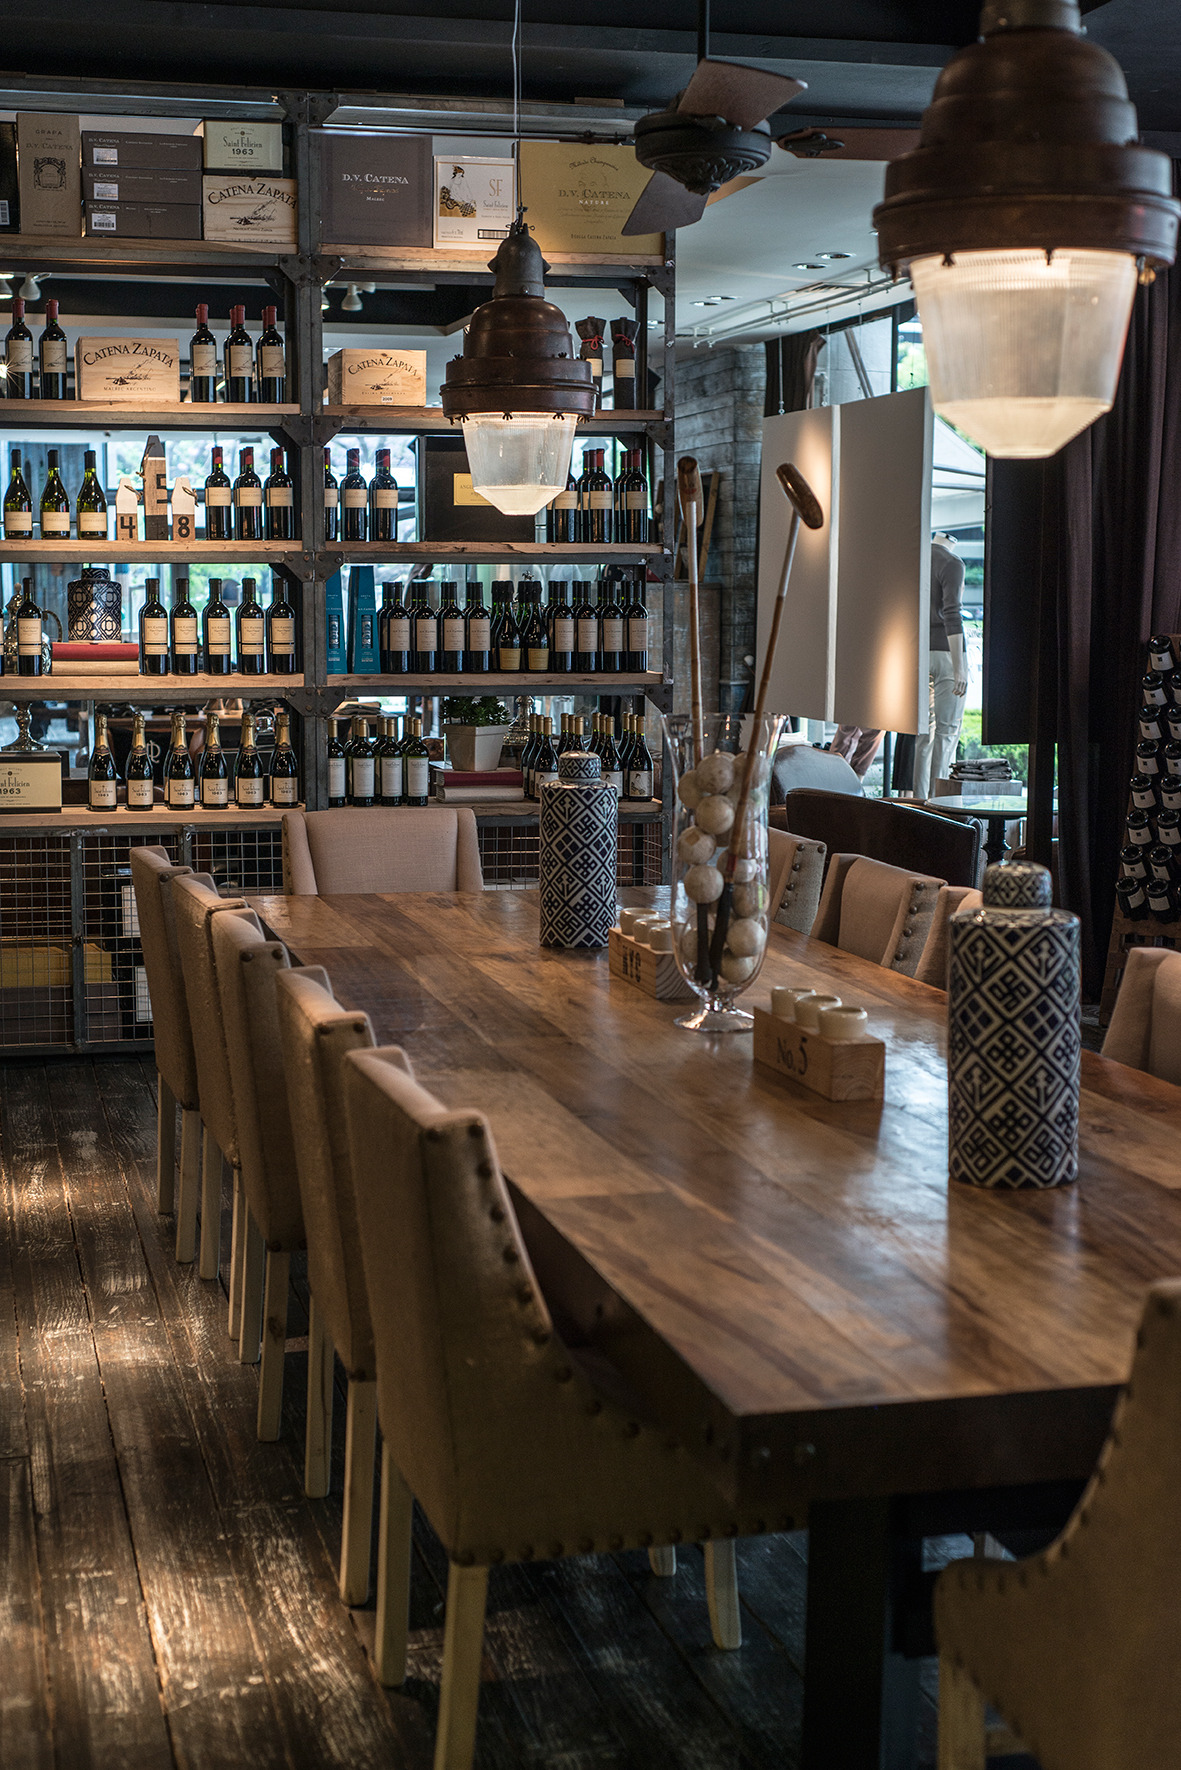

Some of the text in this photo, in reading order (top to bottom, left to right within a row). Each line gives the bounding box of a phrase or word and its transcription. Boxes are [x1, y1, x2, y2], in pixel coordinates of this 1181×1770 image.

[223, 136, 239, 147] Saint
[342, 173, 409, 184] D.V. CATENA
[489, 179, 503, 196] SF
[208, 183, 297, 209] CATENA ZAPATA
[583, 189, 630, 199] CATENA
[83, 343, 174, 368] CATENA ZAPATA
[347, 356, 418, 376] CATENA ZAPATA
[120, 516, 136, 538] 4
[178, 516, 190, 538] 8
